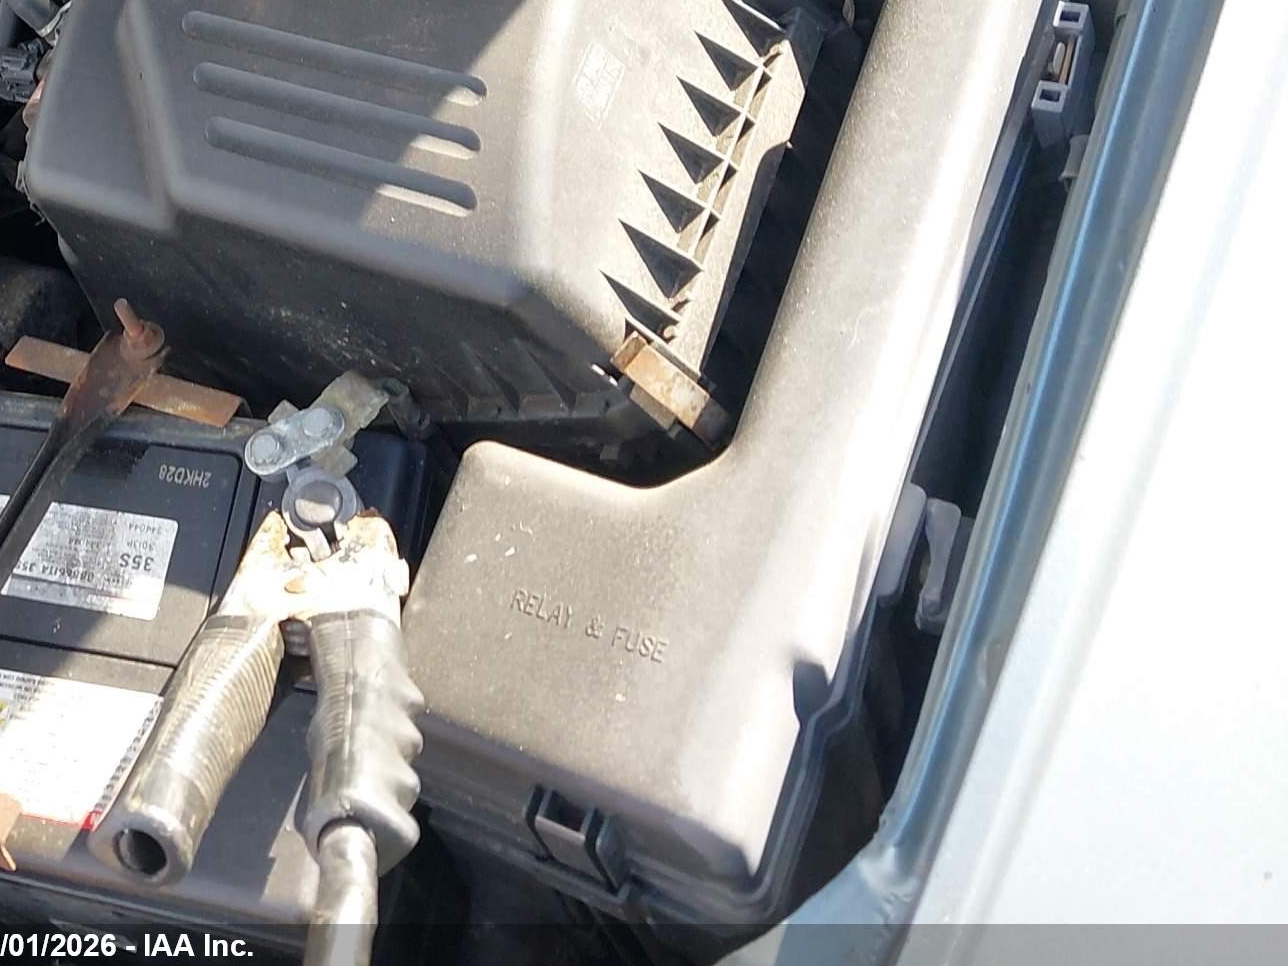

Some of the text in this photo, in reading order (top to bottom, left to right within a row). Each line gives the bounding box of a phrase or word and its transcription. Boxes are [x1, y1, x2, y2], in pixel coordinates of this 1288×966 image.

[158, 463, 212, 489] 2HKD28
[119, 552, 154, 572] 35S
[510, 587, 669, 663] RELAY & FUSE
